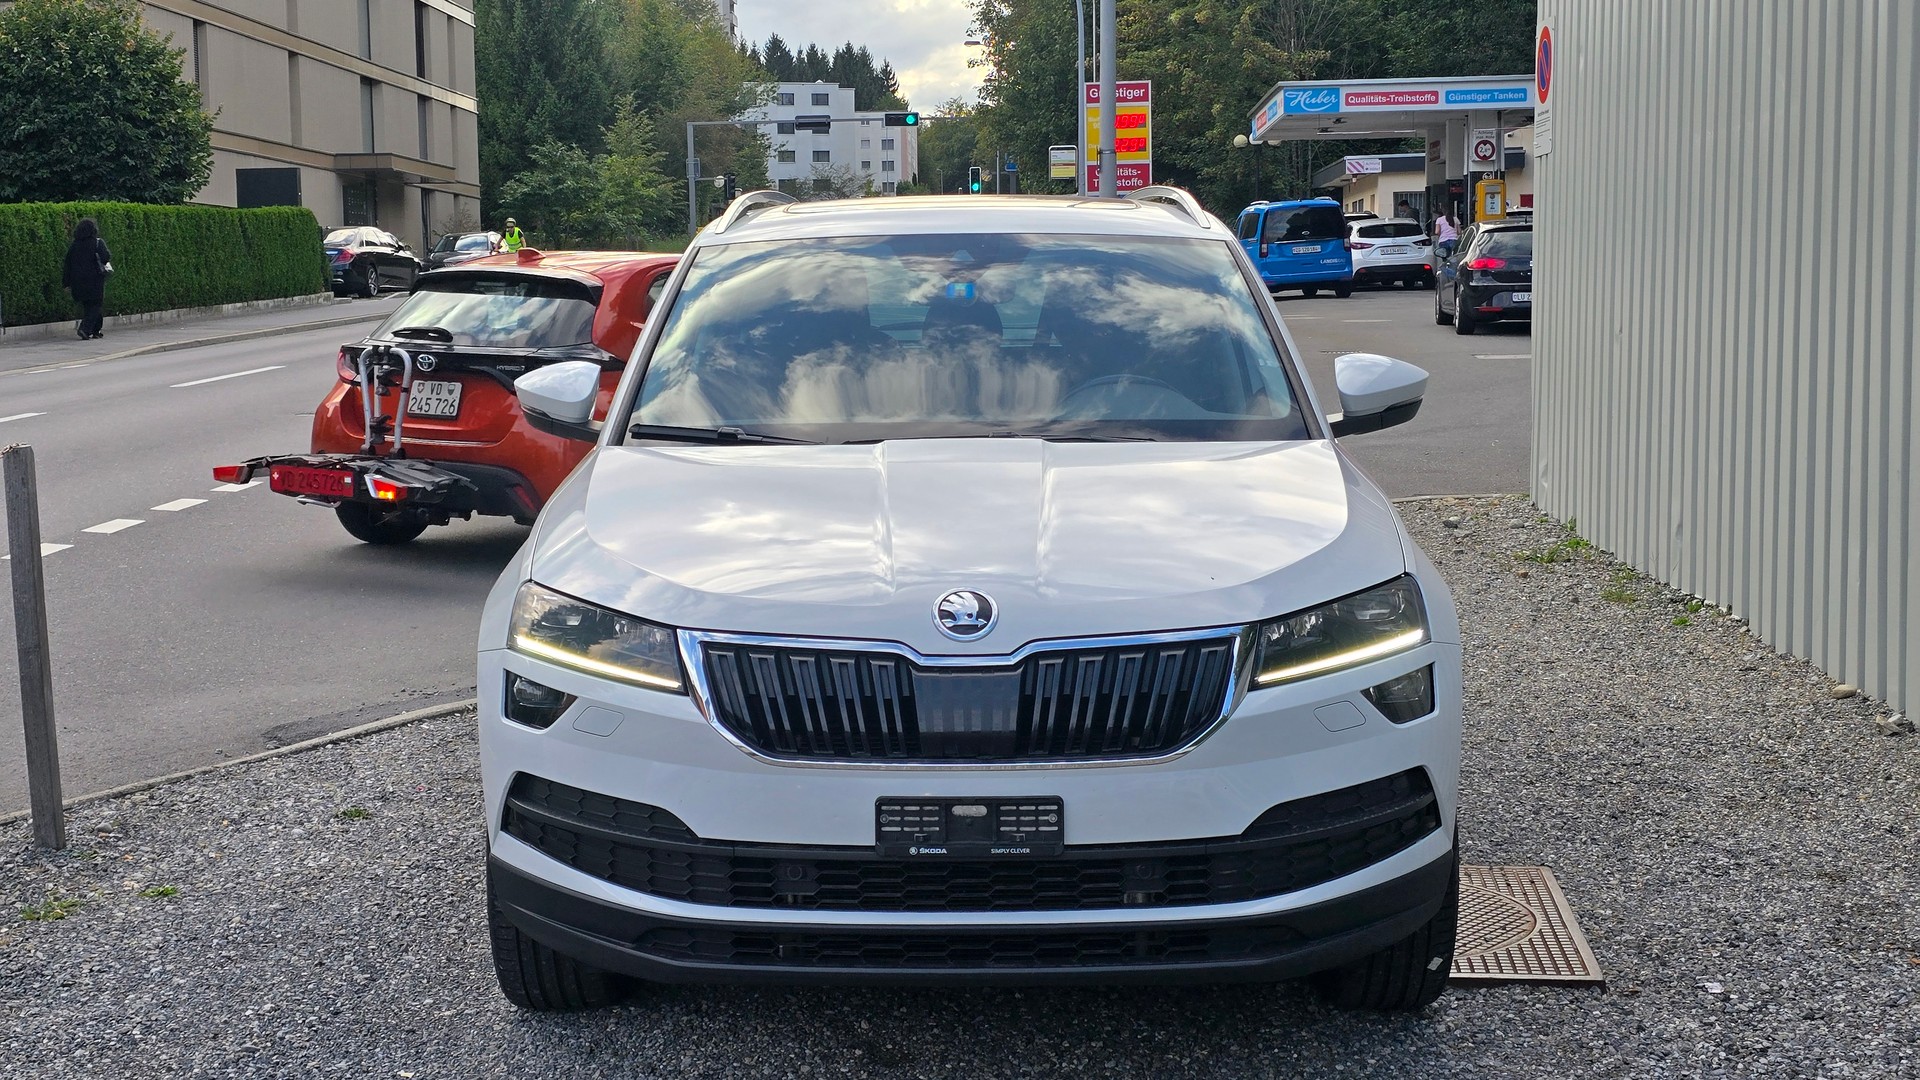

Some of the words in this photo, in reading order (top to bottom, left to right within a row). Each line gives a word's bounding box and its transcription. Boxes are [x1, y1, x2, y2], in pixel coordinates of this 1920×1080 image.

[1089, 87, 1146, 100] Gstiger
[1347, 93, 1437, 104] Qualitäts-Treibstoffe
[1448, 93, 1492, 102] Günstiger
[1493, 91, 1525, 100] Tanken
[1284, 90, 1339, 112] Huber
[1095, 168, 1142, 177] itäts-
[1092, 178, 1143, 187] Tstoffe
[430, 383, 443, 395] VD
[280, 470, 294, 488] VD
